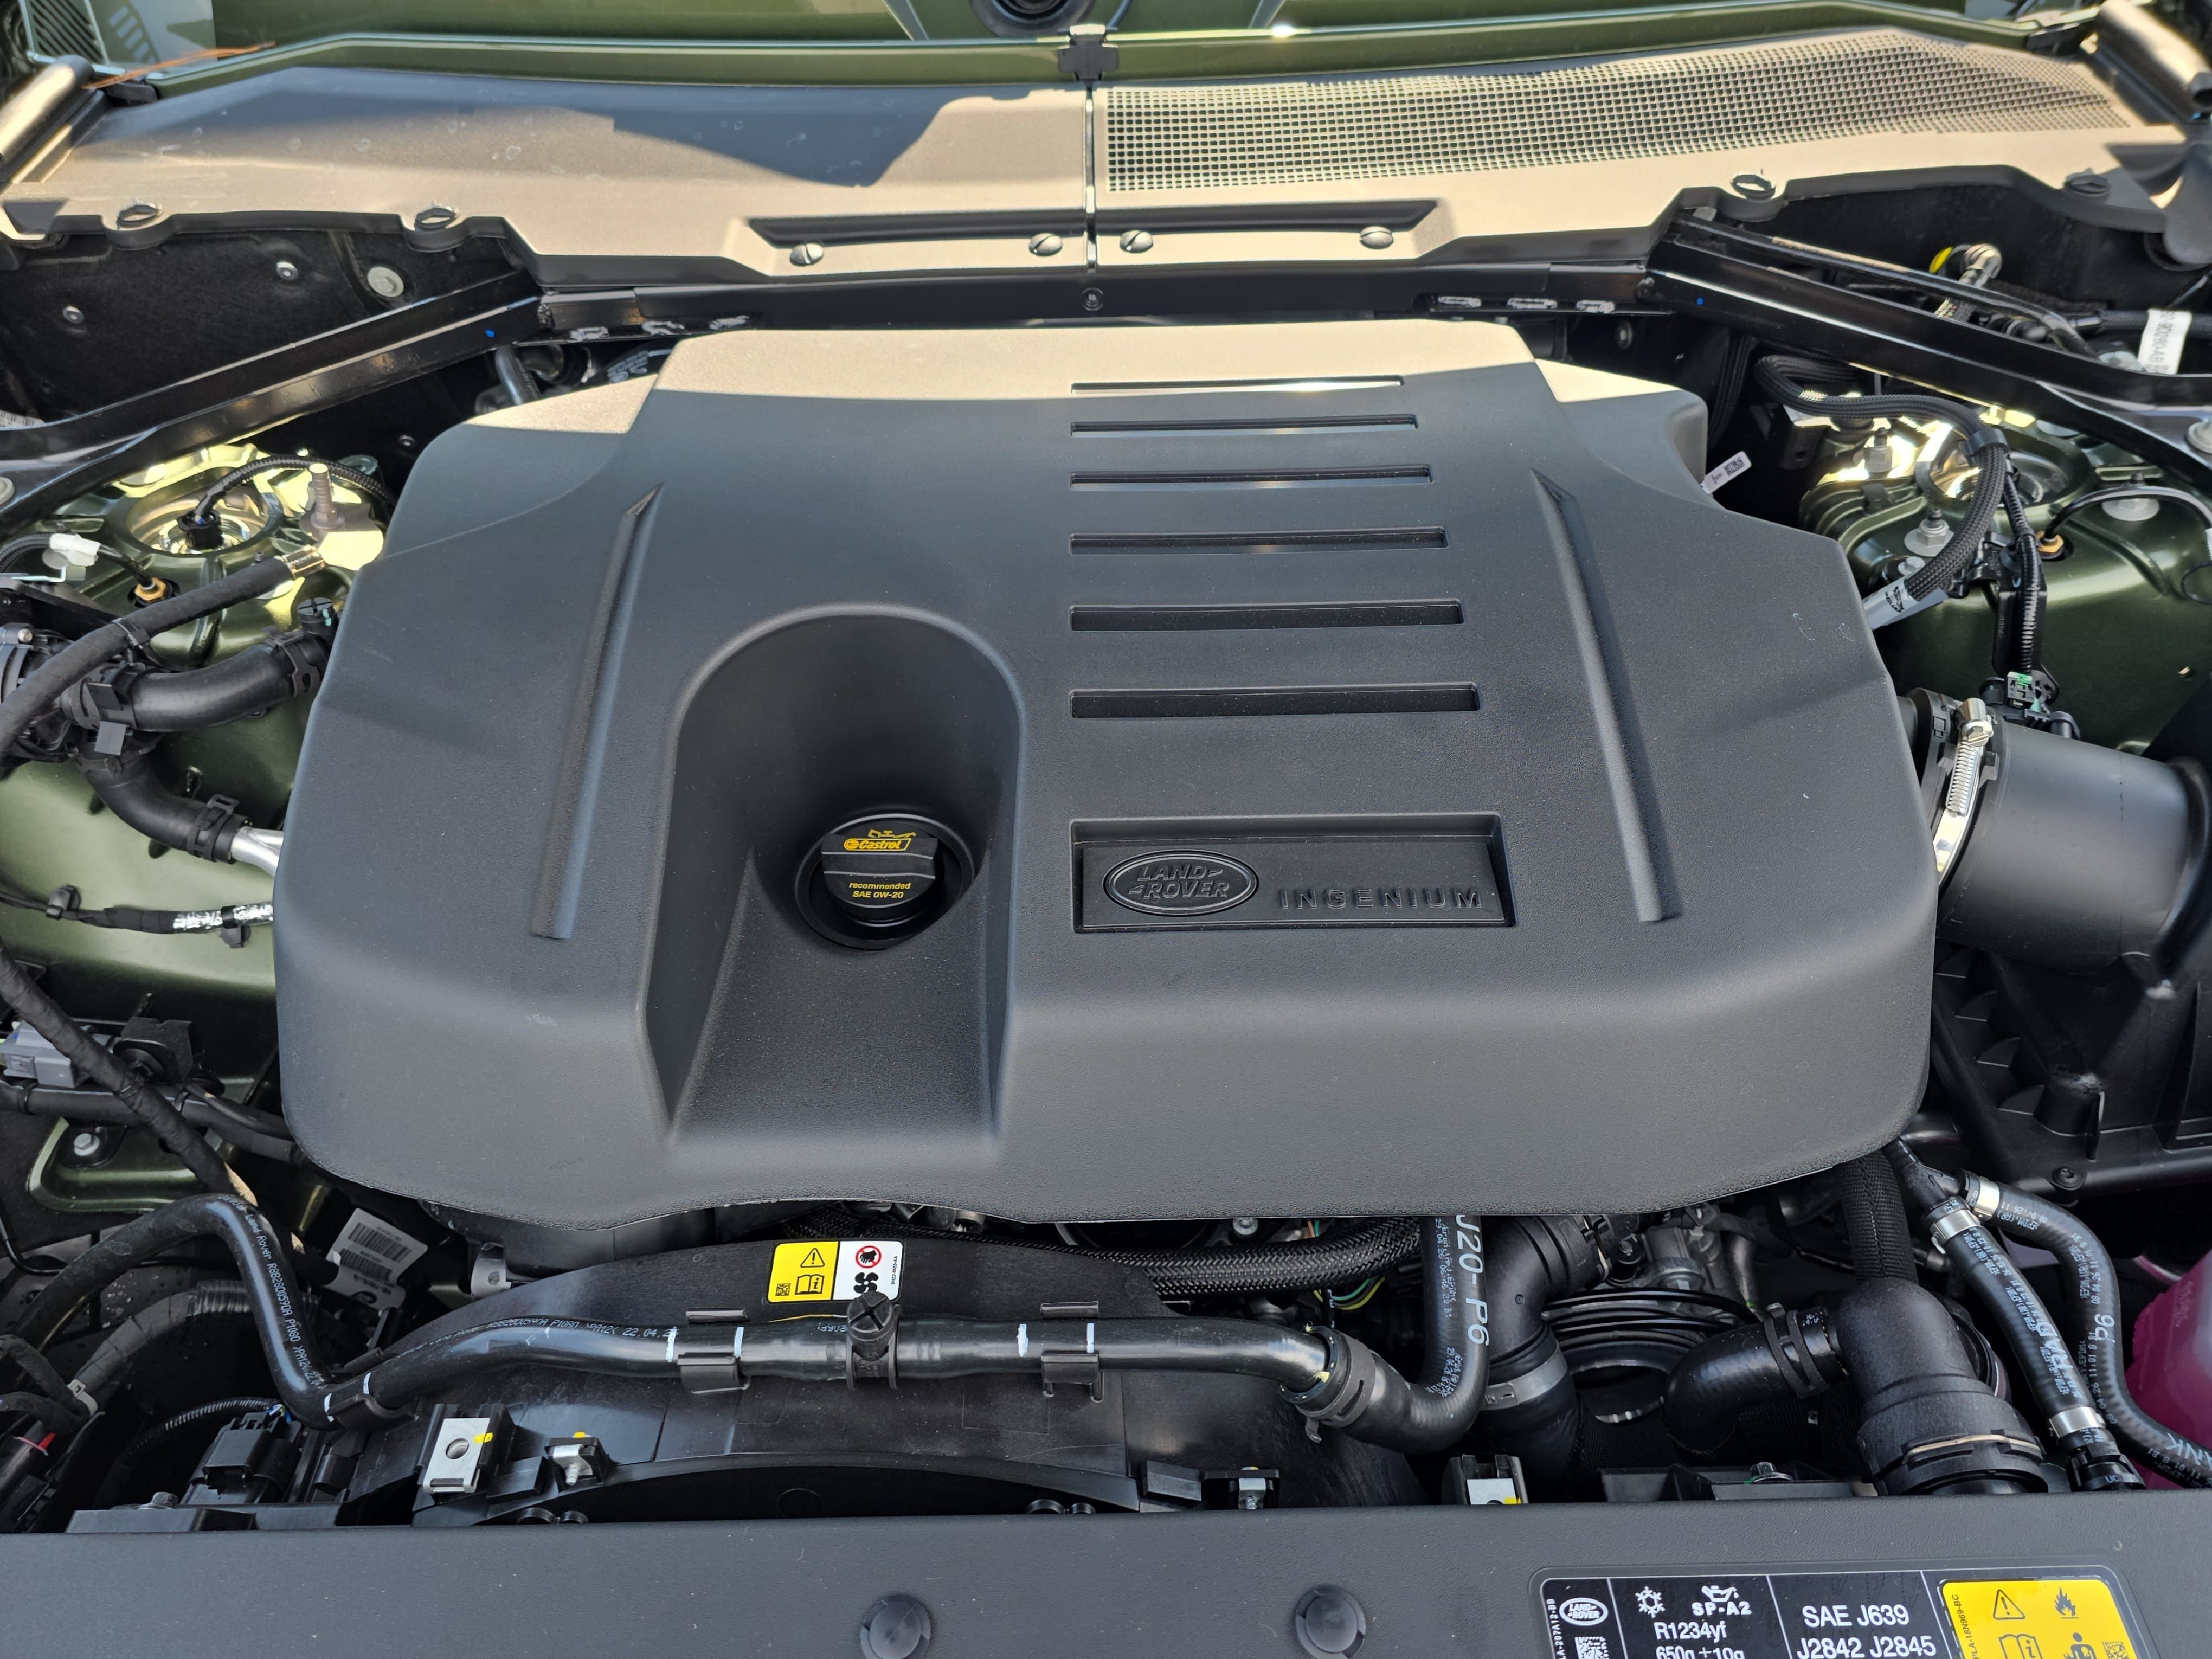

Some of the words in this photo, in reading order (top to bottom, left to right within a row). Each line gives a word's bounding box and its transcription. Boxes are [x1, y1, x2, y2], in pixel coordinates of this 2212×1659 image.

[858, 840, 901, 850] Castrol
[1136, 864, 1210, 881] LAND
[848, 882, 911, 890] recommended
[873, 891, 904, 899] 0W-20
[1144, 880, 1230, 899] ROVER
[1279, 886, 1483, 910] INGENIUM
[245, 1214, 263, 1233] Land
[256, 1235, 272, 1260] Rover
[1465, 1297, 1490, 1347] P6
[622, 1327, 679, 1339] 22.04.2
[2088, 1354, 2098, 1378] 11:01
[1572, 1610, 1600, 1619] ROVER
[1691, 1602, 1752, 1616] SP-A2
[1802, 1605, 1853, 1628] SAE
[1857, 1604, 1909, 1626] J639
[1654, 1621, 1728, 1643] R1234yf
[1796, 1637, 1865, 1659] J2842
[1869, 1635, 1937, 1658] J2845
